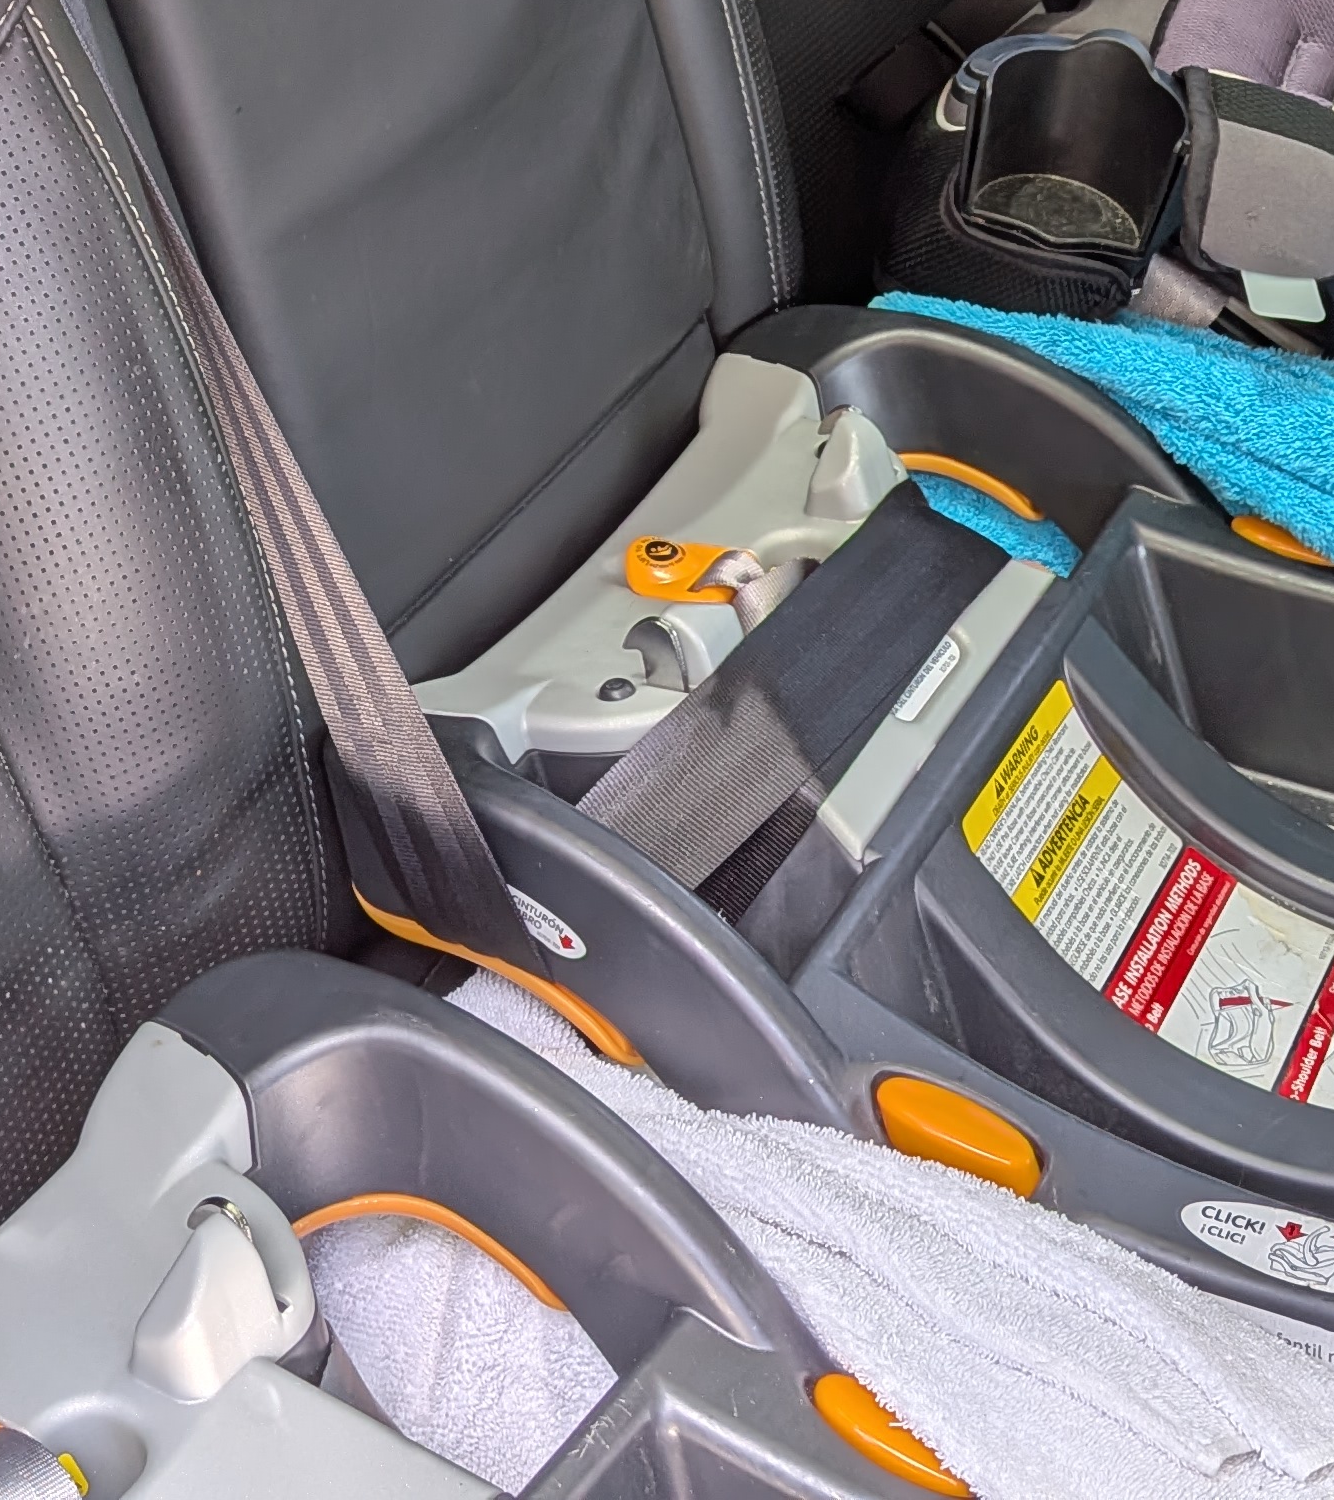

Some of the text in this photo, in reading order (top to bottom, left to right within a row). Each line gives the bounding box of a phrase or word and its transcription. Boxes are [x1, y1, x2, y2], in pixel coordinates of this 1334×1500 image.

[922, 662, 934, 675] DEL
[997, 723, 1041, 785] WARNING
[1034, 791, 1090, 874] ADVERTENCIA
[1122, 907, 1174, 986] INSTALLATION
[1163, 857, 1202, 914] METHODS
[1125, 870, 1214, 1017] MÉTODOS DE DE LA BASE
[1145, 999, 1165, 1024] Belt
[1307, 1025, 1329, 1049] Belt
[1199, 1204, 1267, 1235] CLICK!
[1199, 1223, 1246, 1245] ¡CLIC!
